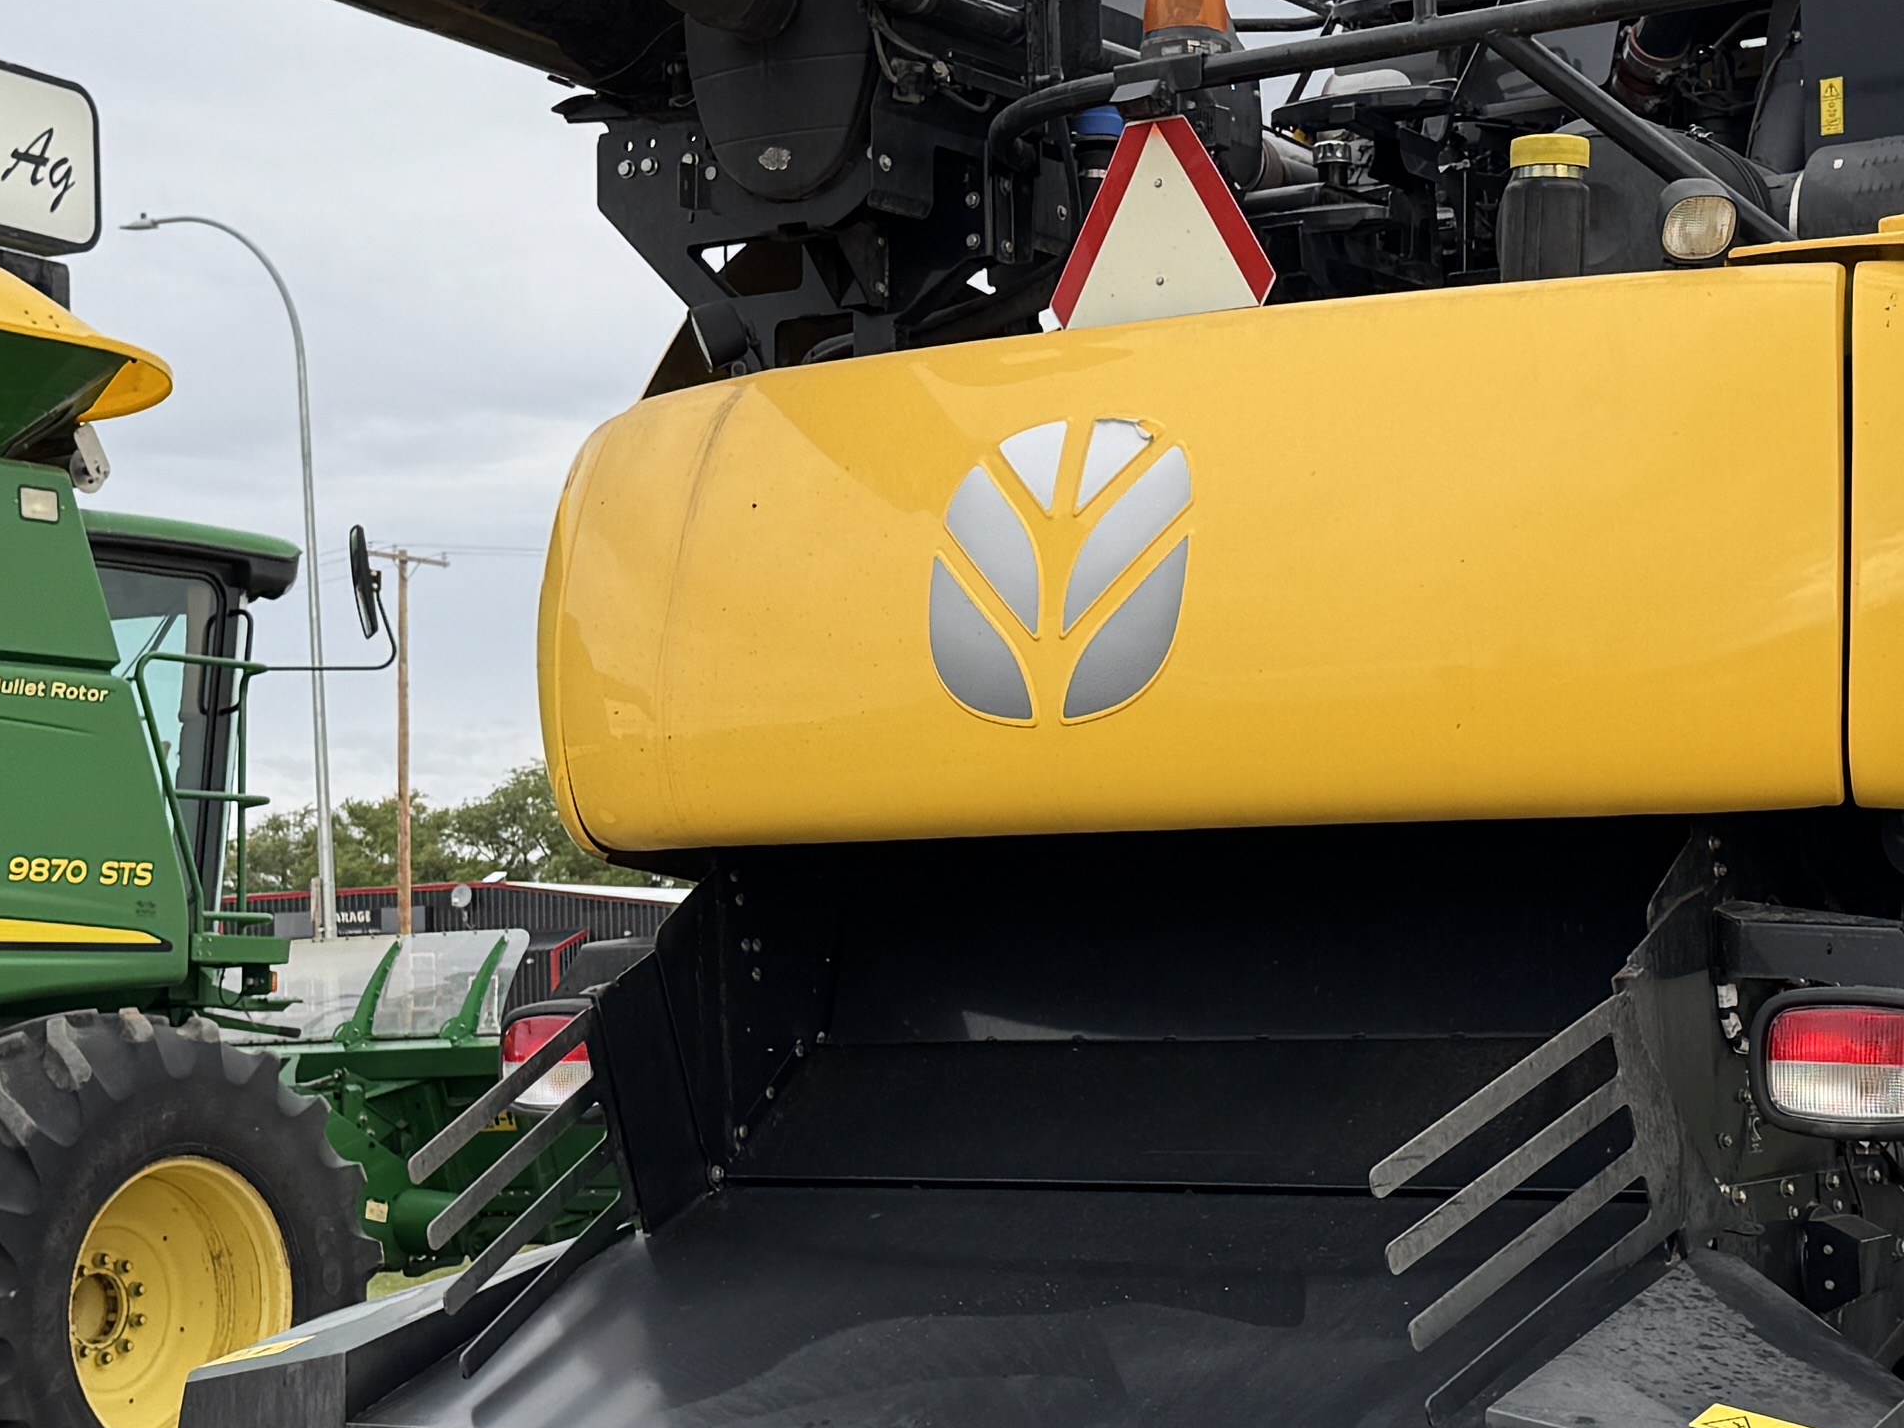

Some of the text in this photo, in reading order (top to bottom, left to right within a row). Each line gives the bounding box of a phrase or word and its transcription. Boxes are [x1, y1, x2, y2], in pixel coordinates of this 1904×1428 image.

[0, 127, 77, 213] Ag
[50, 681, 110, 703] Rotor
[8, 856, 155, 887] 9870 STS
